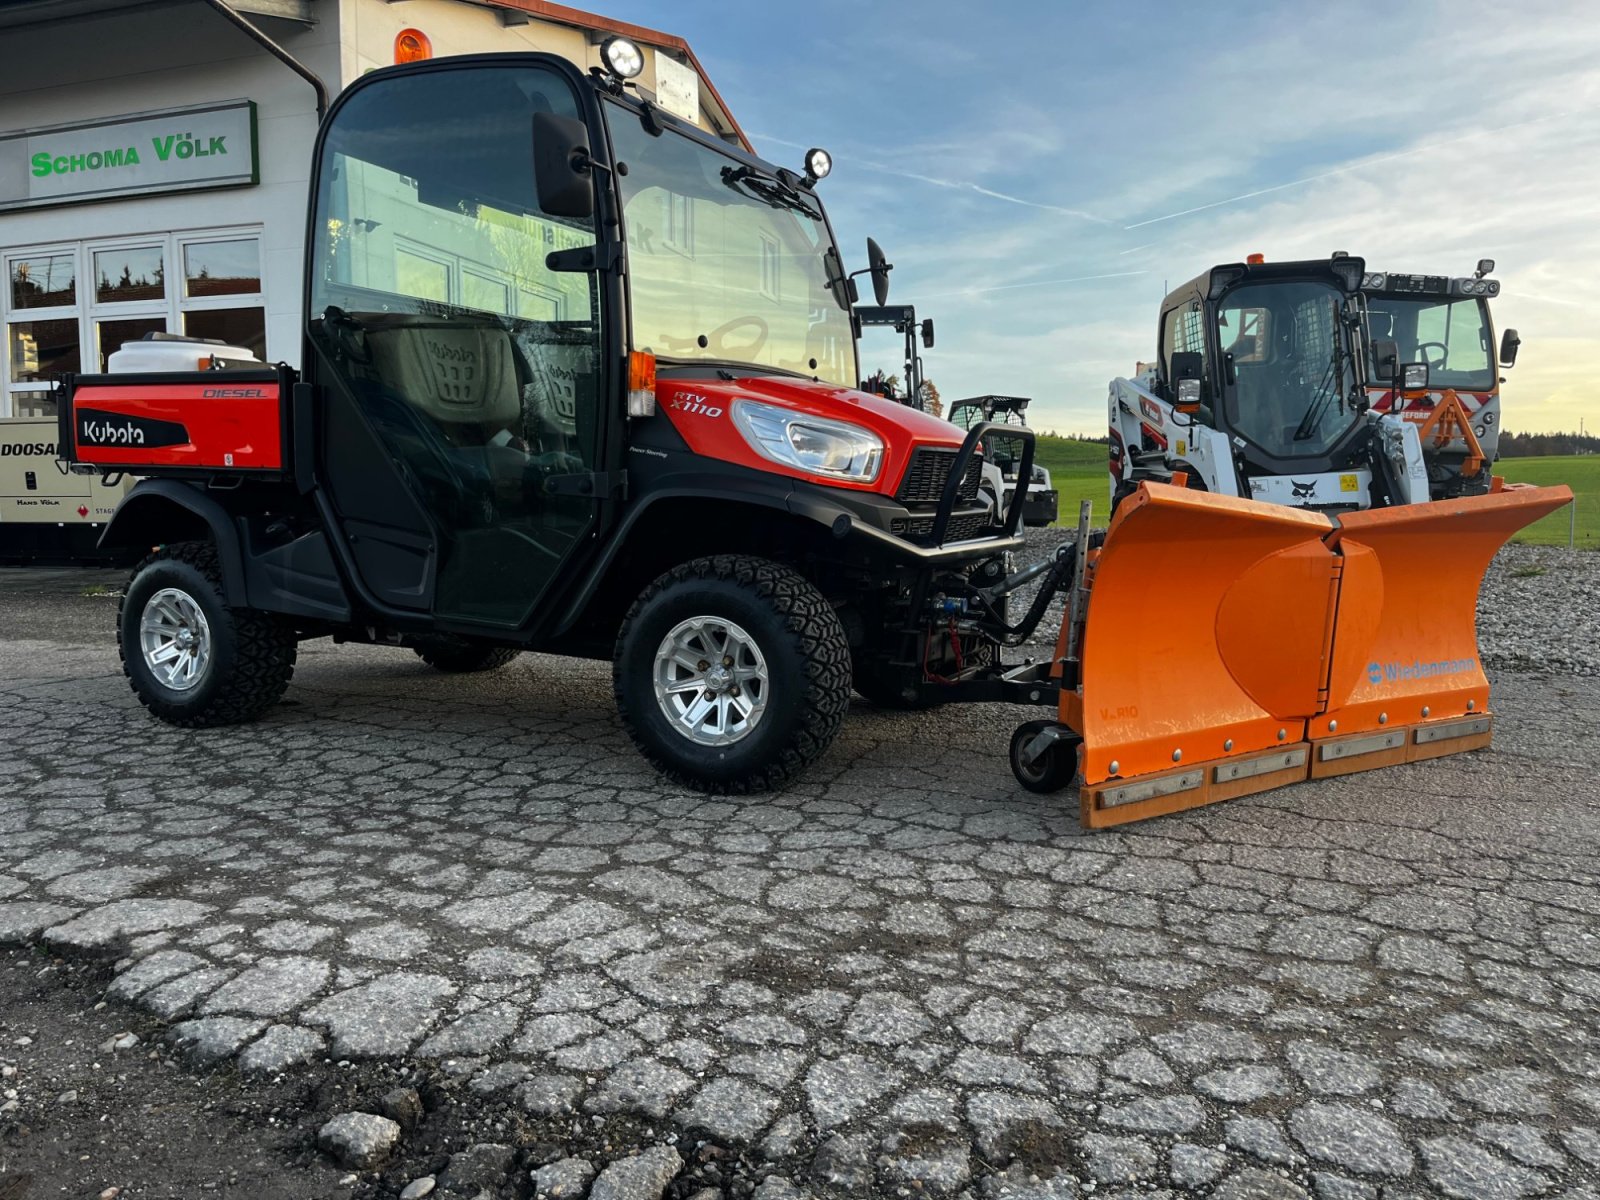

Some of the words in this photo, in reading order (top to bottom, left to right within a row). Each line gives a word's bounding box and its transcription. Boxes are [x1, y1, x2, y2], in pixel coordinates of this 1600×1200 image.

[202, 388, 268, 398] DIESEL
[674, 391, 707, 403] RTV
[669, 400, 723, 418] X1110
[83, 420, 145, 444] Kubota
[1, 443, 60, 456] DOOSA
[1384, 657, 1475, 682] Wiedenmann
